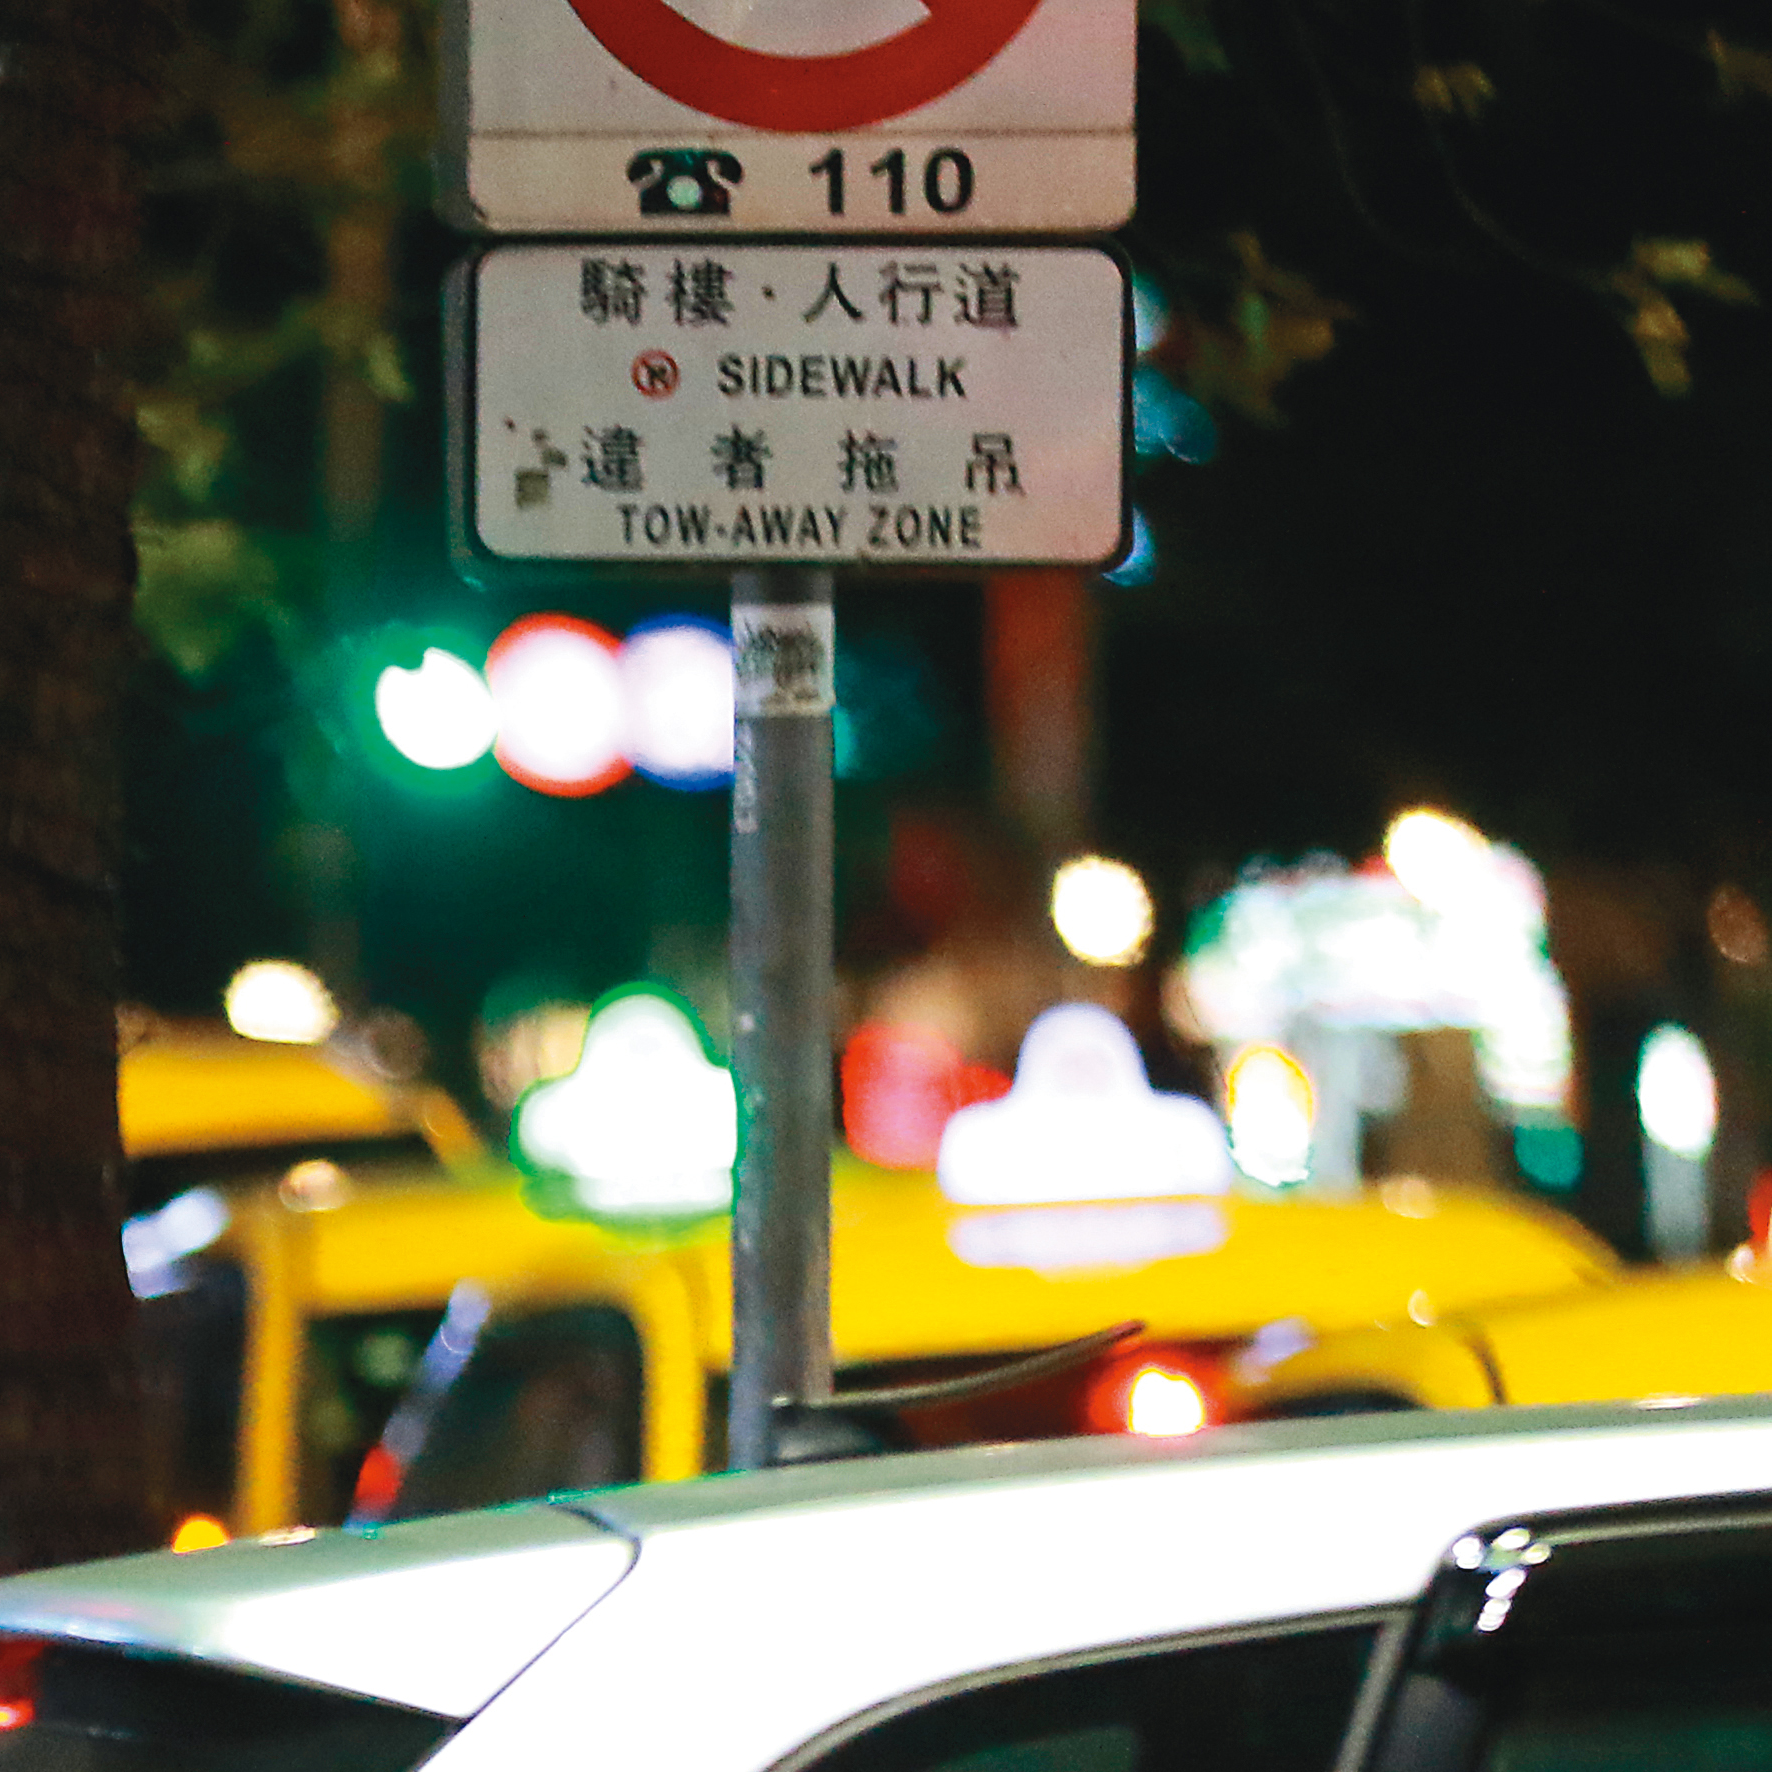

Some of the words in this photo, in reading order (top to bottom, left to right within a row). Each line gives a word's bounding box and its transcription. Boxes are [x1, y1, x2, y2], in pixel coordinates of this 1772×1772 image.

[809, 148, 975, 214] 110
[716, 352, 968, 401] SIDEWALK
[617, 505, 850, 547] TOW-AWAY
[867, 505, 983, 549] ZONE
